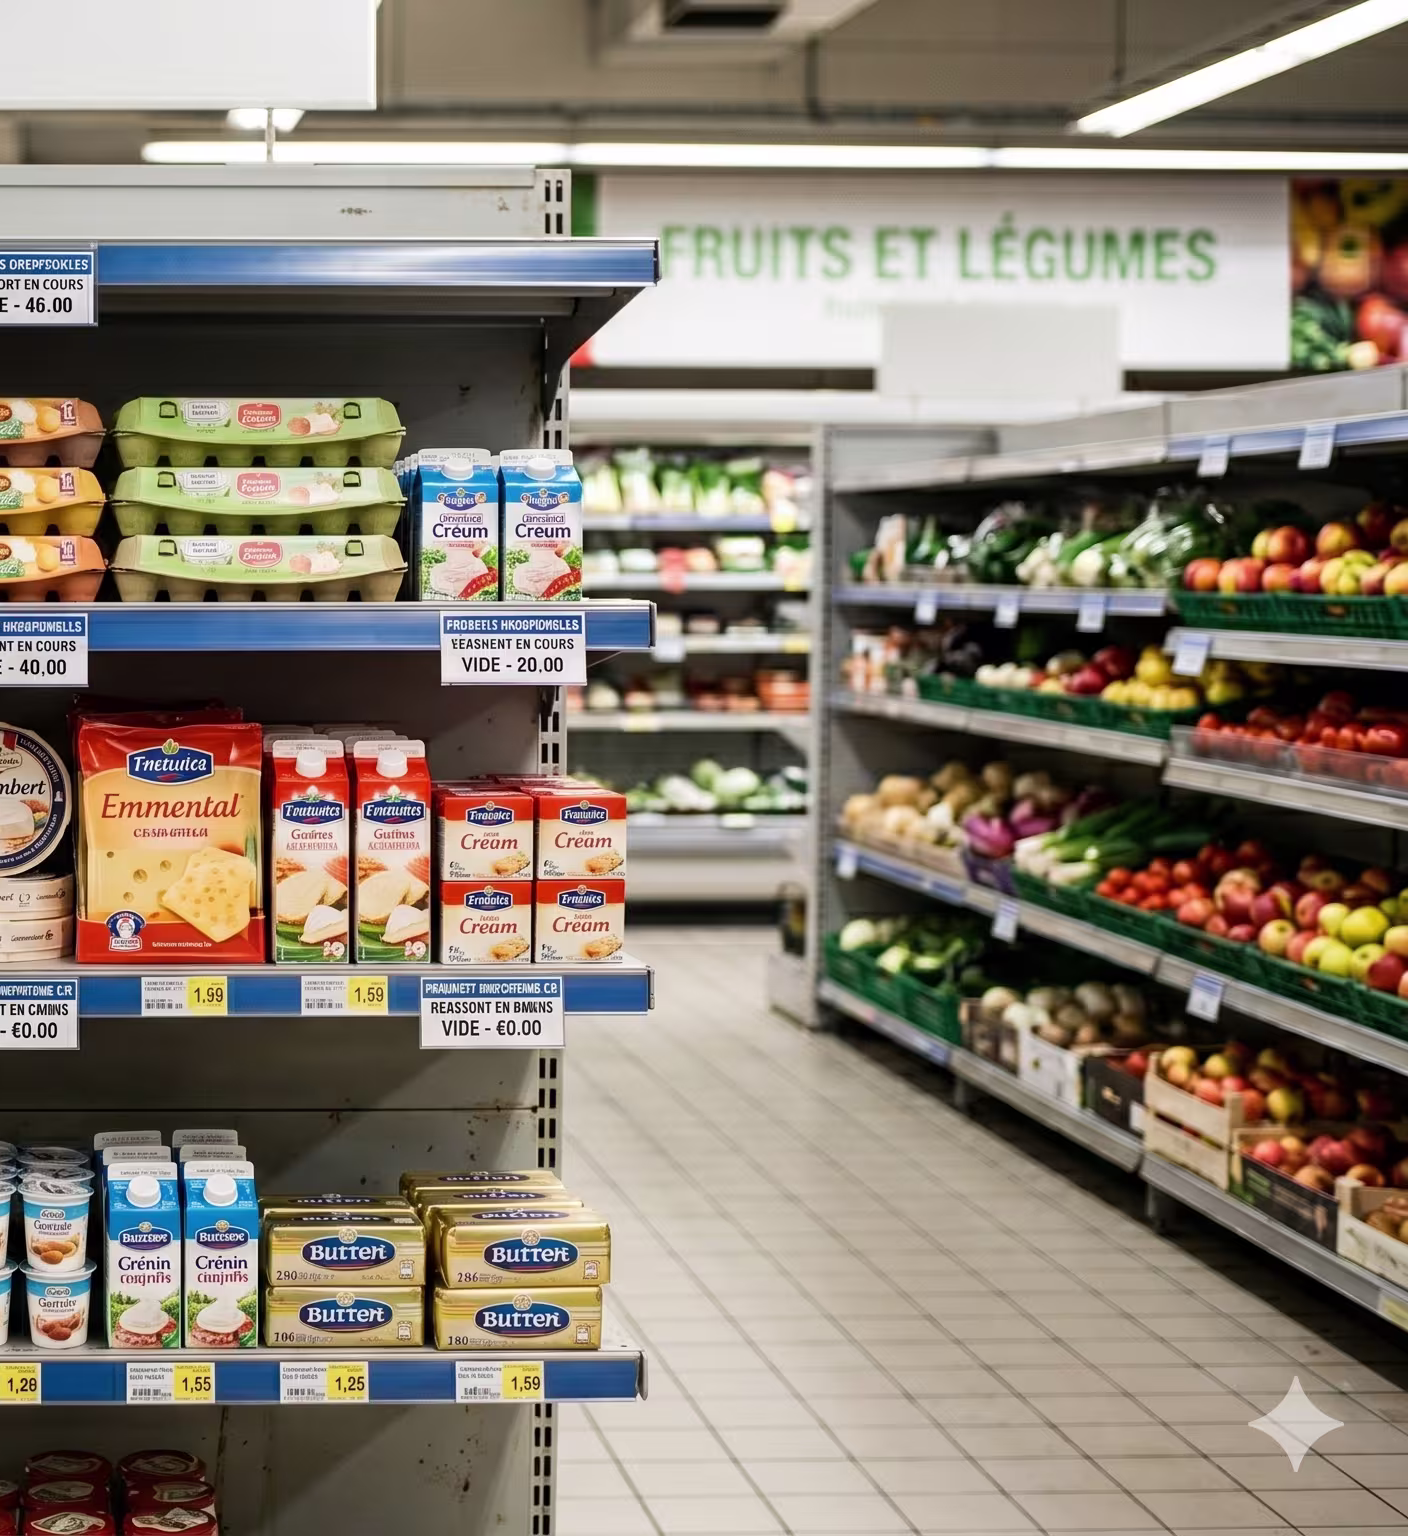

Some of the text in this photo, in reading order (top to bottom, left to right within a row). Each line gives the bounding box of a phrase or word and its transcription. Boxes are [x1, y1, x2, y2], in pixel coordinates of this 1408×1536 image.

[661, 212, 1218, 283] FRUITS ET LÉGUMES
[24, 278, 40, 291] EN
[42, 278, 84, 291] COURS
[25, 297, 73, 313] 46.00
[17, 640, 33, 652] EN
[36, 640, 77, 652] COURS
[516, 638, 531, 650] EN
[534, 638, 575, 650] COURS
[461, 657, 501, 672] VIDE
[101, 792, 241, 819] Emmental
[460, 833, 519, 850] Cream
[554, 832, 612, 849] Cream
[459, 917, 518, 935] Cream
[552, 916, 610, 933] Cream
[354, 987, 384, 1003] 1,59
[10, 1003, 25, 1016] EN
[430, 1001, 492, 1014] REASSONT
[495, 1001, 510, 1014] EN
[11, 1022, 58, 1039] €0.00
[441, 1020, 480, 1036] VIDE
[496, 1020, 542, 1036] €0.00
[457, 1272, 479, 1283] 286
[447, 1335, 469, 1346] 180
[7, 1377, 38, 1395] 1,28
[181, 1376, 211, 1394] 1,55
[335, 1375, 365, 1393] 1,25
[511, 1375, 541, 1393] 1,59
